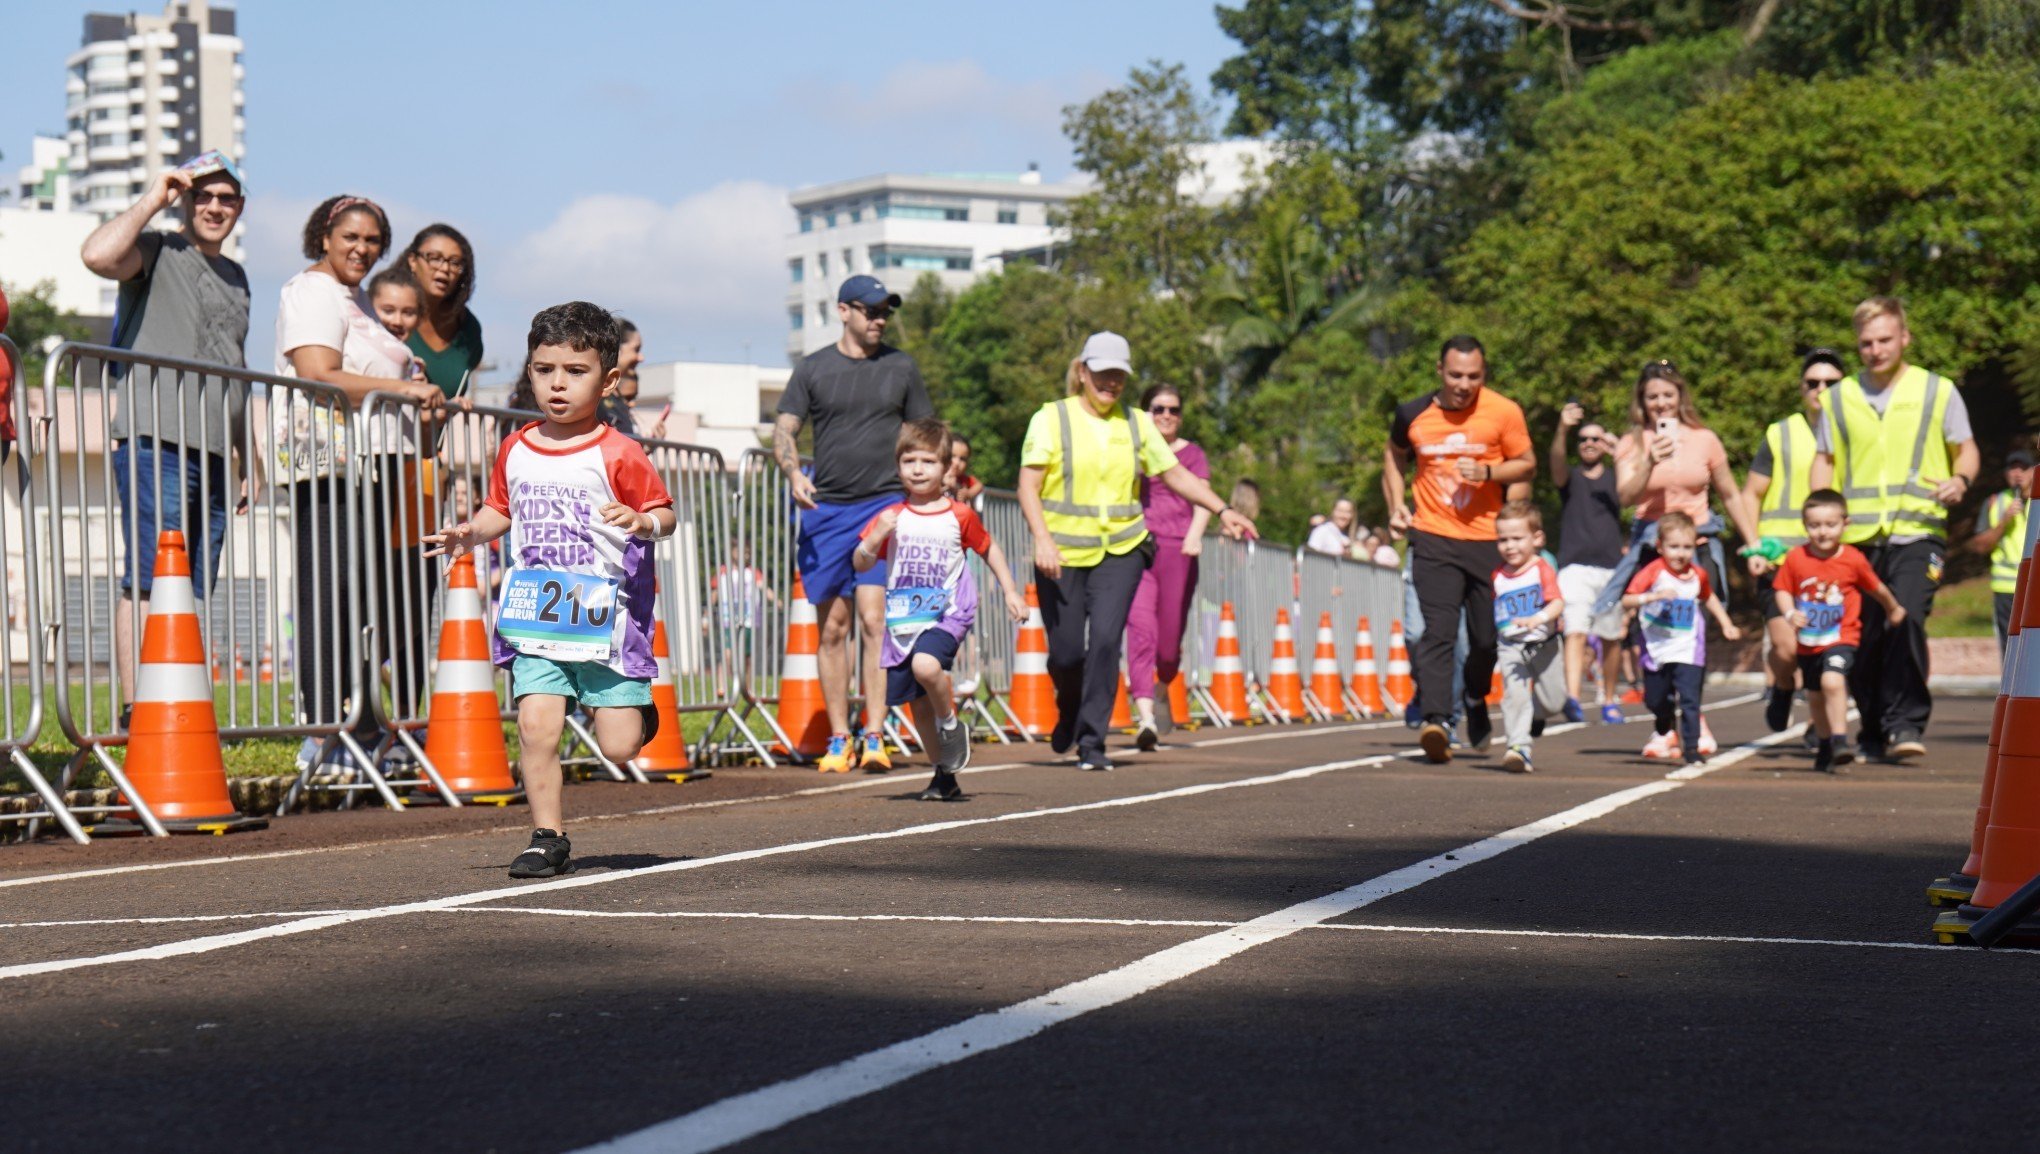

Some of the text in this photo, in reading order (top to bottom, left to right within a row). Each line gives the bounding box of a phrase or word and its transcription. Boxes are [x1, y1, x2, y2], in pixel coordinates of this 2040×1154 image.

[533, 485, 588, 501] FEEVALE
[518, 499, 566, 521] KIDS
[522, 522, 594, 544] TEENS
[541, 545, 595, 567] RUN
[897, 545, 931, 561] KIDS
[898, 561, 947, 577] TEENS
[508, 587, 529, 599] KIDS
[507, 598, 538, 610] TEENS
[538, 580, 610, 627] 210
[514, 609, 537, 621] RUN
